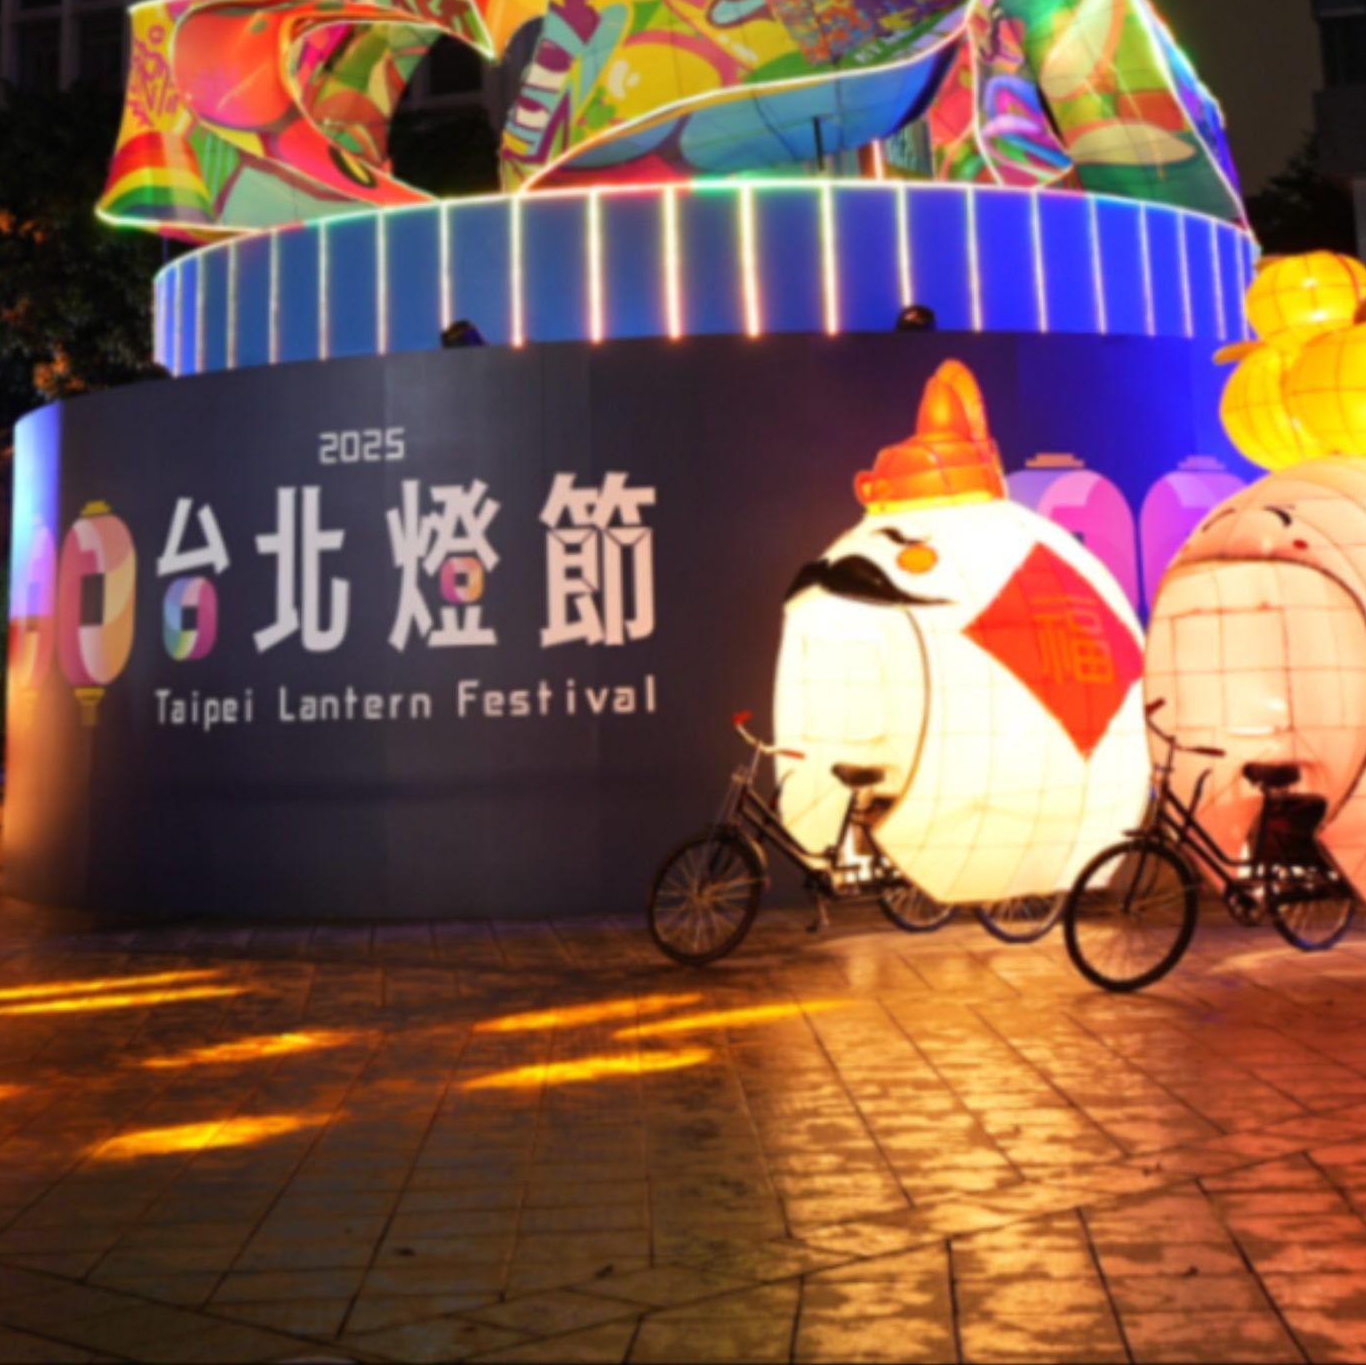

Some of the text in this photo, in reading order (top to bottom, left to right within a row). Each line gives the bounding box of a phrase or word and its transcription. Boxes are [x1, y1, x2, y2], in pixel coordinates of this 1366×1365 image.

[319, 427, 405, 464] 2025
[156, 471, 656, 662] 台北燈節
[1029, 593, 1116, 685] 福
[155, 673, 657, 732] Taipei Lantern Festival
